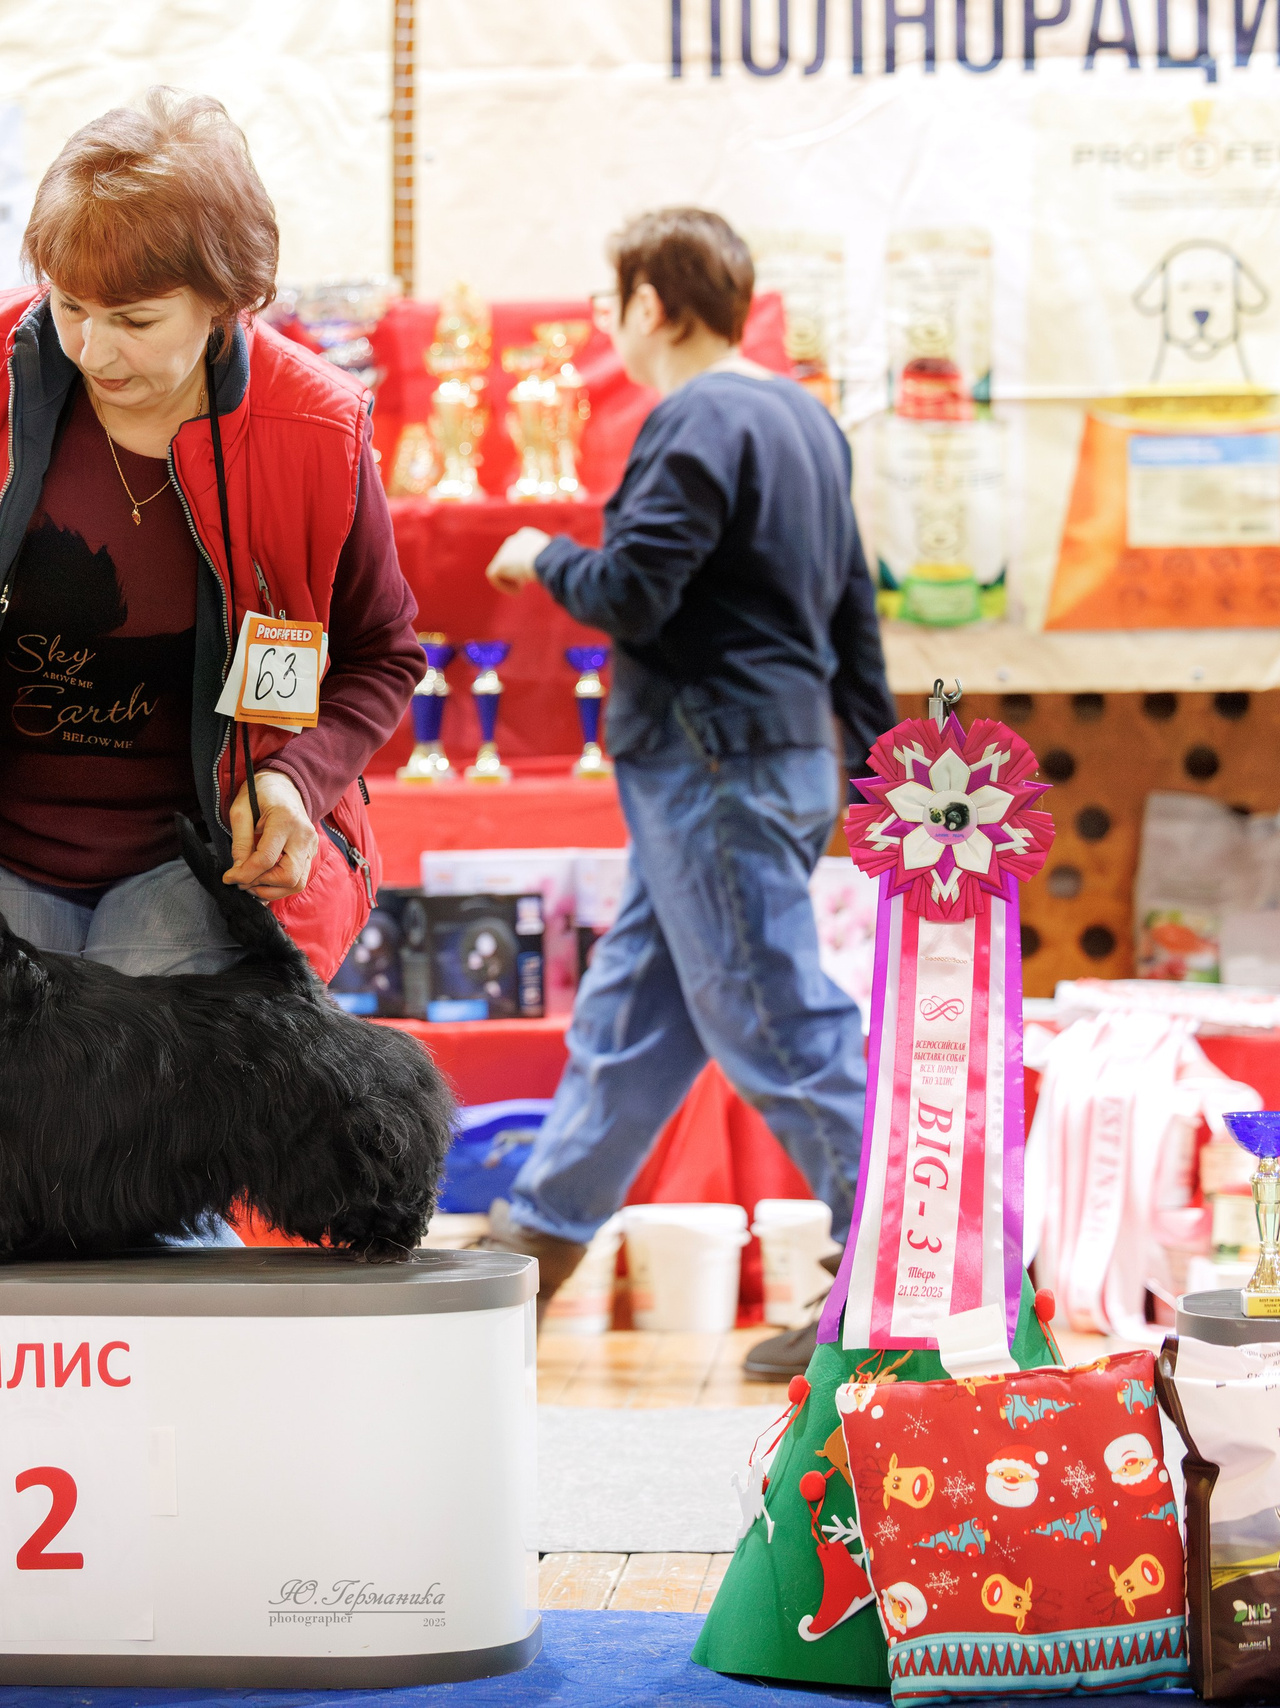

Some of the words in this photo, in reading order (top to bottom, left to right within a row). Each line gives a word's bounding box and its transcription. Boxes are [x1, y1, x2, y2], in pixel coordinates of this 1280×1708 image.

[6, 634, 96, 675] Sky
[42, 671, 77, 686] ABOVE
[77, 679, 94, 690] ME
[255, 647, 297, 700] 63
[11, 682, 160, 736] Earth
[62, 731, 112, 746] BELOW
[113, 740, 134, 749] ME
[915, 1040, 966, 1051] ВСЕРОССИЙСКАЯ
[914, 1051, 945, 1062] ВЫСТАВКА
[946, 1053, 966, 1063] СОБАК
[920, 1064, 935, 1073] ВСЕХ
[937, 1065, 958, 1075] ПОРОД
[912, 1097, 954, 1191] BIG
[906, 1229, 942, 1254] 3
[907, 1266, 936, 1285] Тверь
[897, 1284, 944, 1298] 21.12.2025
[15, 1466, 84, 1571] 2
